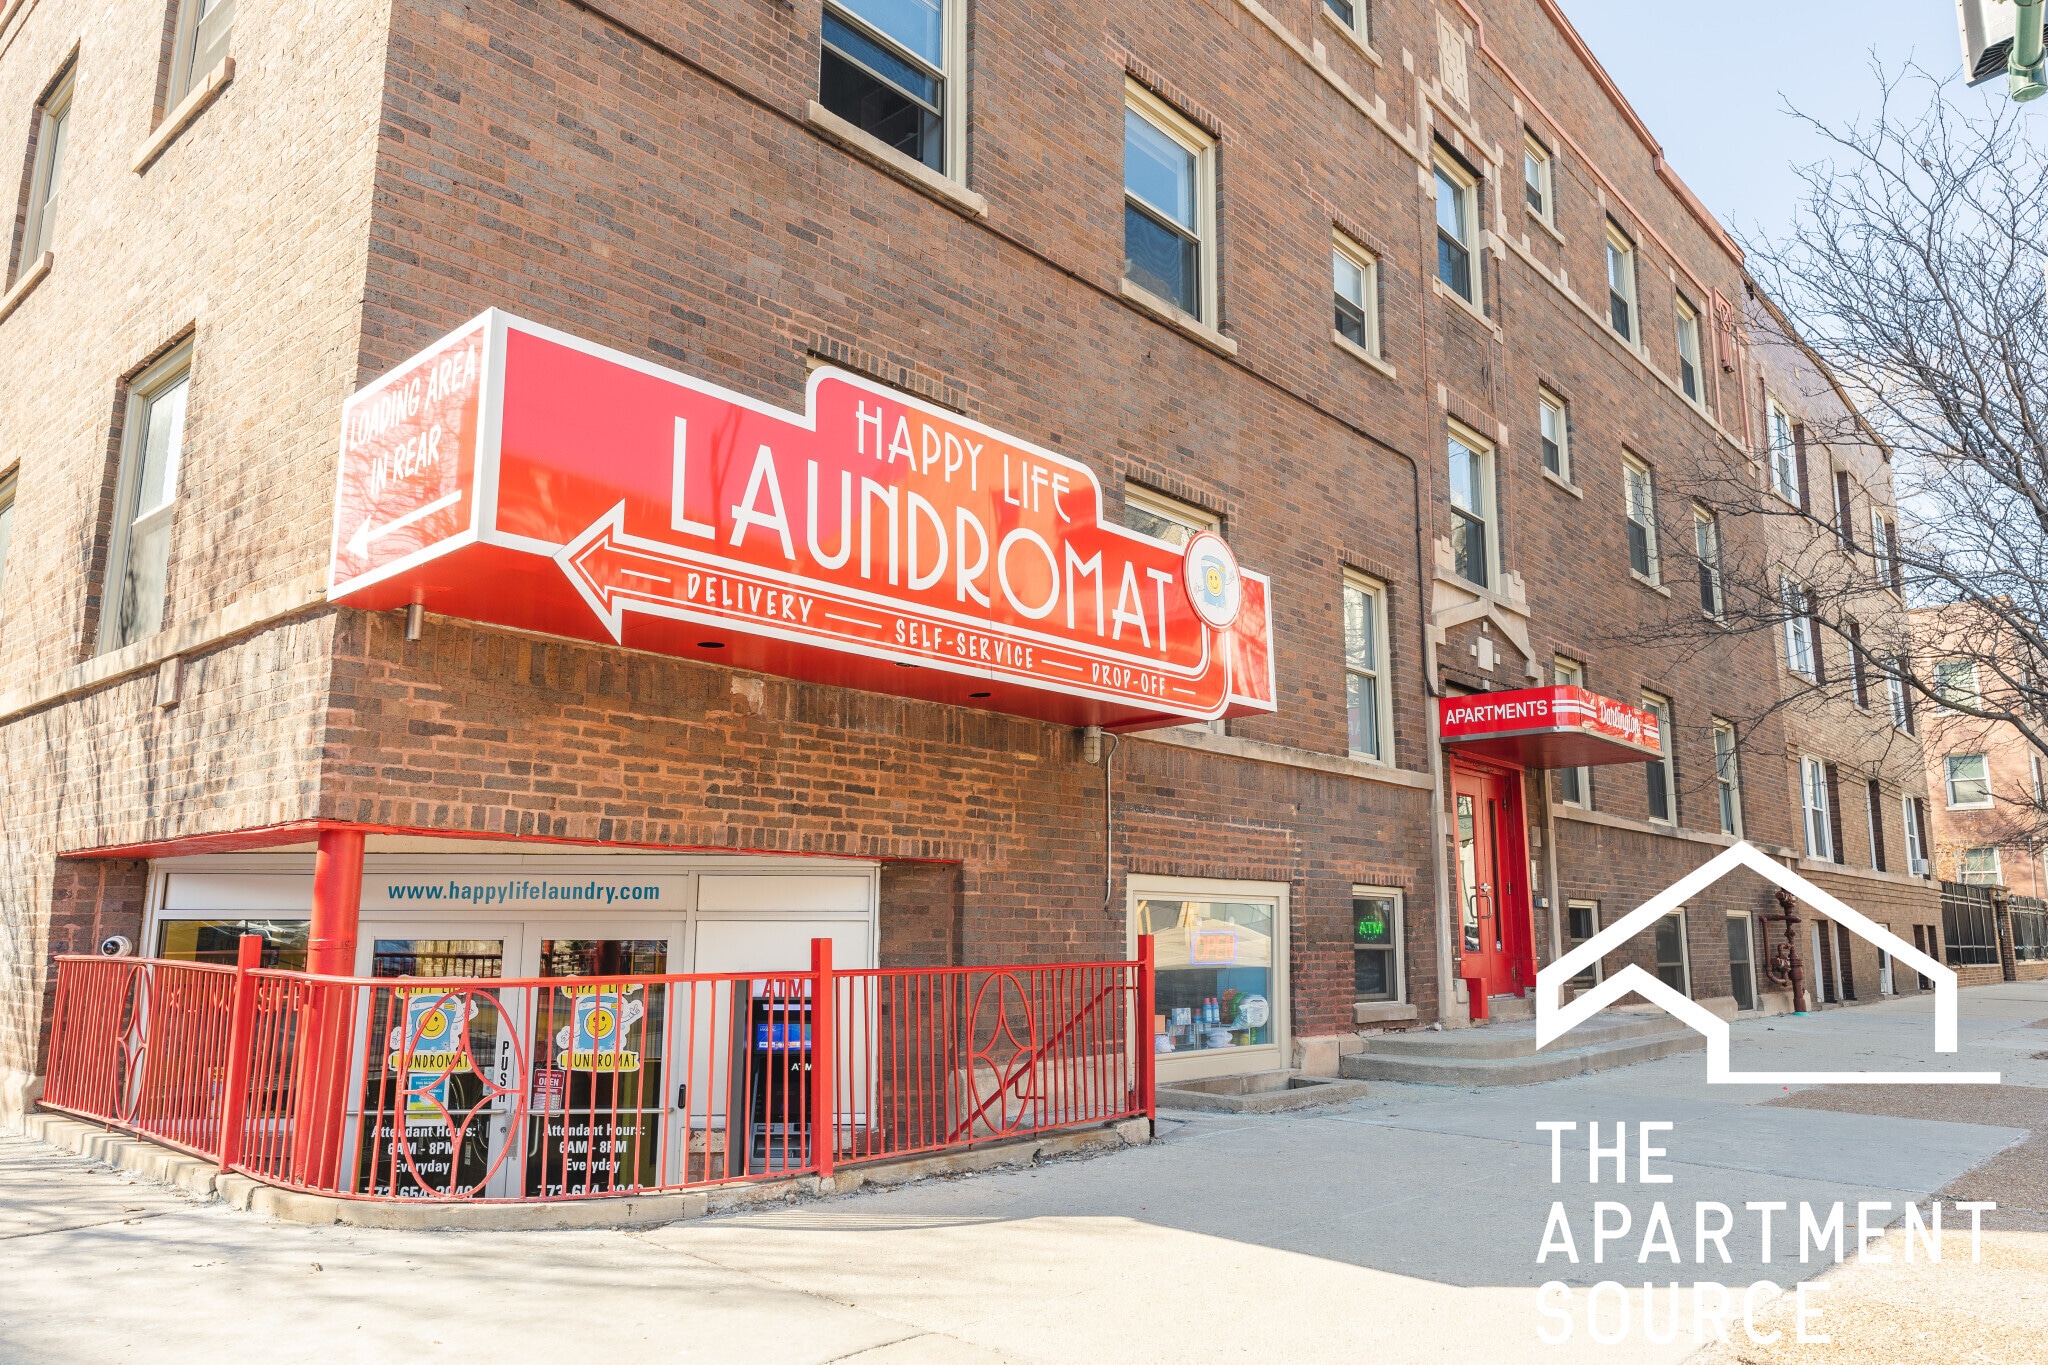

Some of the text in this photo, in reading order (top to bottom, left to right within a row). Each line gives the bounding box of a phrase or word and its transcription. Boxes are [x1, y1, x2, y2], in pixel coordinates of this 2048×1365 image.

[349, 344, 475, 452] LOADING AREA
[371, 425, 441, 496] IN REAR
[856, 401, 1071, 522] HAPPY LIFE
[671, 415, 1173, 653] LAUNDROMAT
[686, 572, 813, 624] DELIVERY
[895, 619, 1034, 669] SELF-SERVICE
[1091, 663, 1166, 696] DROP-OFF
[1446, 700, 1548, 725] APARTMENTS
[387, 880, 660, 905] www.happylifelaundry.com
[1358, 920, 1383, 935] ATM
[1194, 935, 1235, 961] OPEN
[391, 1054, 468, 1069] LUNDROMAT
[560, 1053, 637, 1068] LUNROMAT
[791, 1063, 812, 1071] AM
[371, 1126, 434, 1138] Attedant
[394, 1160, 450, 1175] Evryday
[566, 1158, 621, 1174] Eveyday
